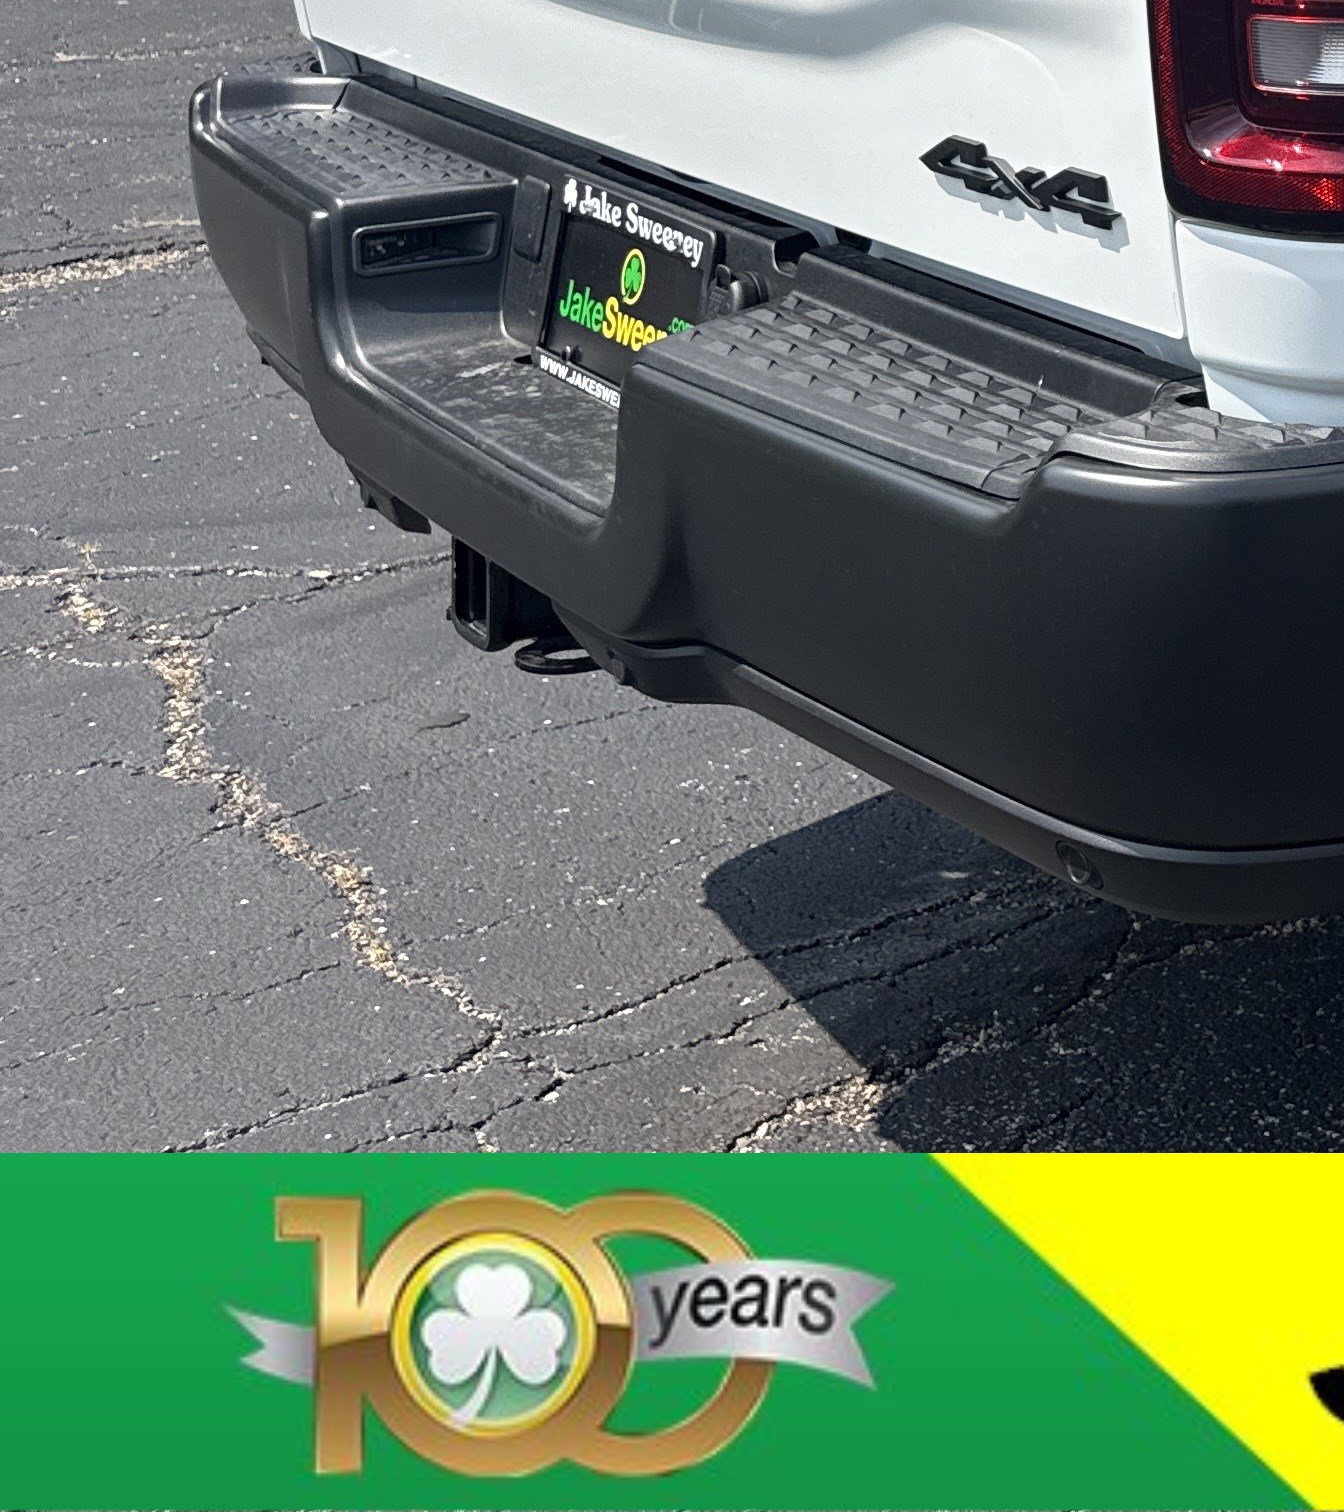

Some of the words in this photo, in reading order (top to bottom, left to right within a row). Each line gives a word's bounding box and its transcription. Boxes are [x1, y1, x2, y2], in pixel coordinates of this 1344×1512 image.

[580, 185, 622, 227] Jake
[626, 202, 704, 268] Sweeney
[540, 354, 621, 408] WWW.JAKESWE
